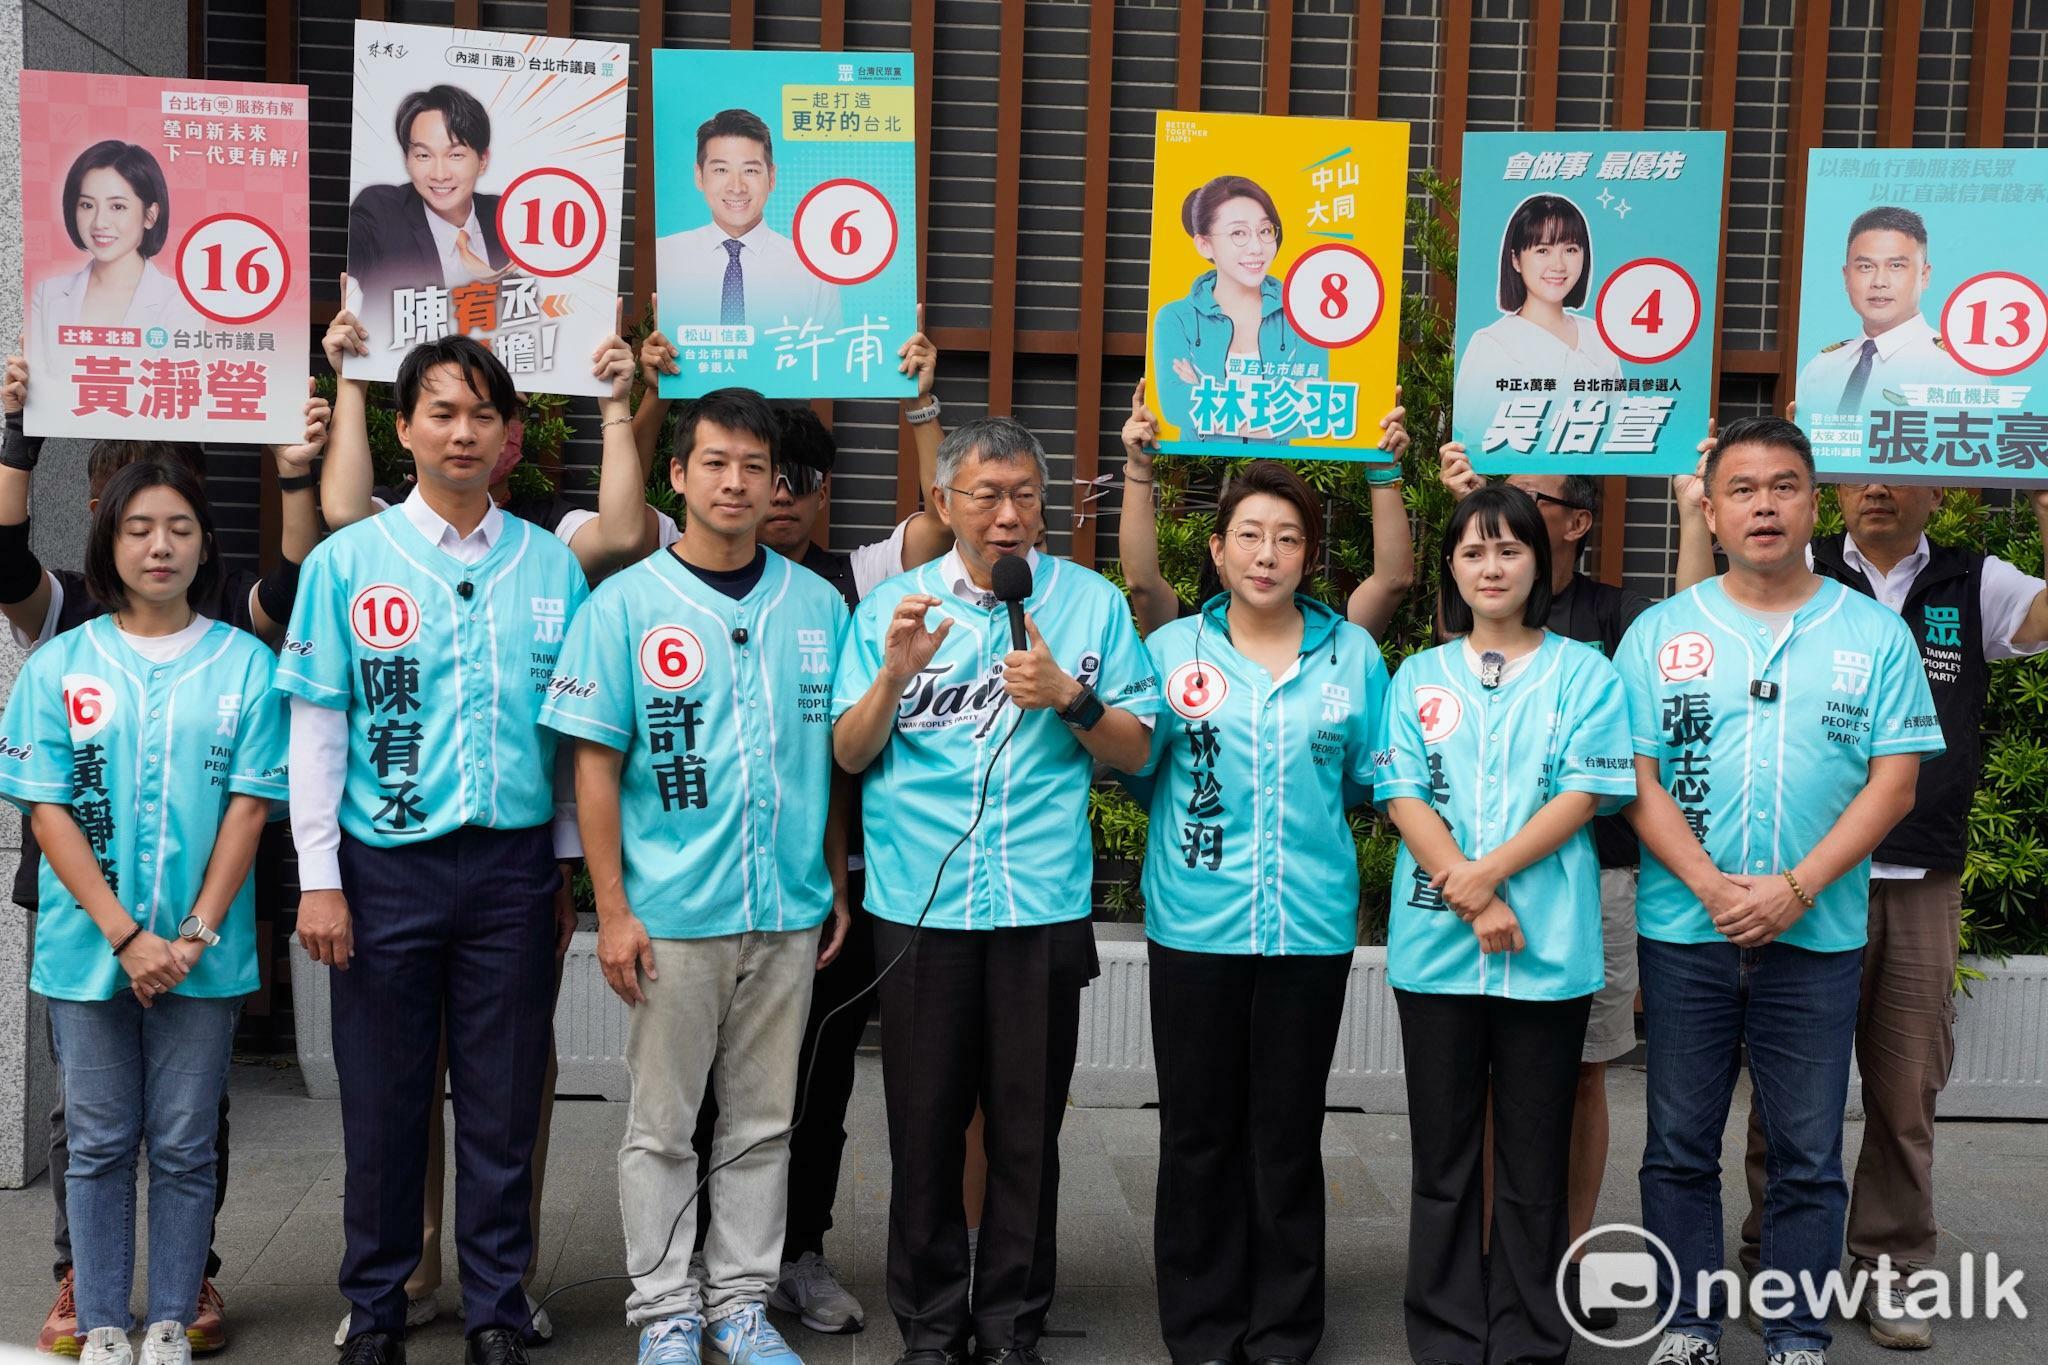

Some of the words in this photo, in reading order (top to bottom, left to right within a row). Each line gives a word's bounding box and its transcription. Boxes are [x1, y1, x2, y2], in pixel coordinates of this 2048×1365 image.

[455, 51, 480, 64] 內湖
[491, 54, 516, 67] 南港
[528, 57, 597, 76] 台北市議員
[791, 92, 871, 109] 一起打造
[792, 110, 902, 132] 更好的台北
[1311, 162, 1360, 194] 中山
[1502, 152, 1593, 180] 會做事
[1596, 151, 1687, 181] 最優先
[1817, 157, 2017, 178] 以熱血行動服務民眾
[1868, 183, 2048, 203] 以正直誠信實踐承
[519, 198, 586, 249] 10
[1306, 194, 1356, 228] 大同
[830, 209, 862, 256] 6
[200, 243, 271, 295] 16
[1319, 273, 1349, 320] 8
[1631, 289, 1664, 334] 4
[389, 278, 540, 351] 陳宥丞
[1963, 300, 2031, 347] 13
[173, 329, 275, 351] 台北市議員
[684, 328, 712, 342] 松山
[764, 314, 890, 383] 許甫
[1247, 361, 1320, 377] 台北市議員
[71, 355, 268, 421] 黃瀞瑩
[1927, 387, 2001, 405] 熱血機長
[1189, 376, 1359, 439] 林珍羽
[1482, 396, 1677, 455] 吳怡萱
[1868, 410, 2048, 470] 張志豪
[362, 597, 409, 638] 10
[530, 653, 558, 665] TAIW
[658, 638, 688, 678] 6
[1666, 643, 1705, 670] 13
[1925, 647, 1961, 661] TAIWAN
[1183, 671, 1210, 707] 8
[1928, 671, 1957, 684] PARTY
[1418, 697, 1442, 732] 4
[1826, 700, 1869, 718] TAIWAN
[360, 655, 429, 835] 陳宥丞
[646, 695, 709, 812] 許甫
[1181, 720, 1226, 871] 林珍羽
